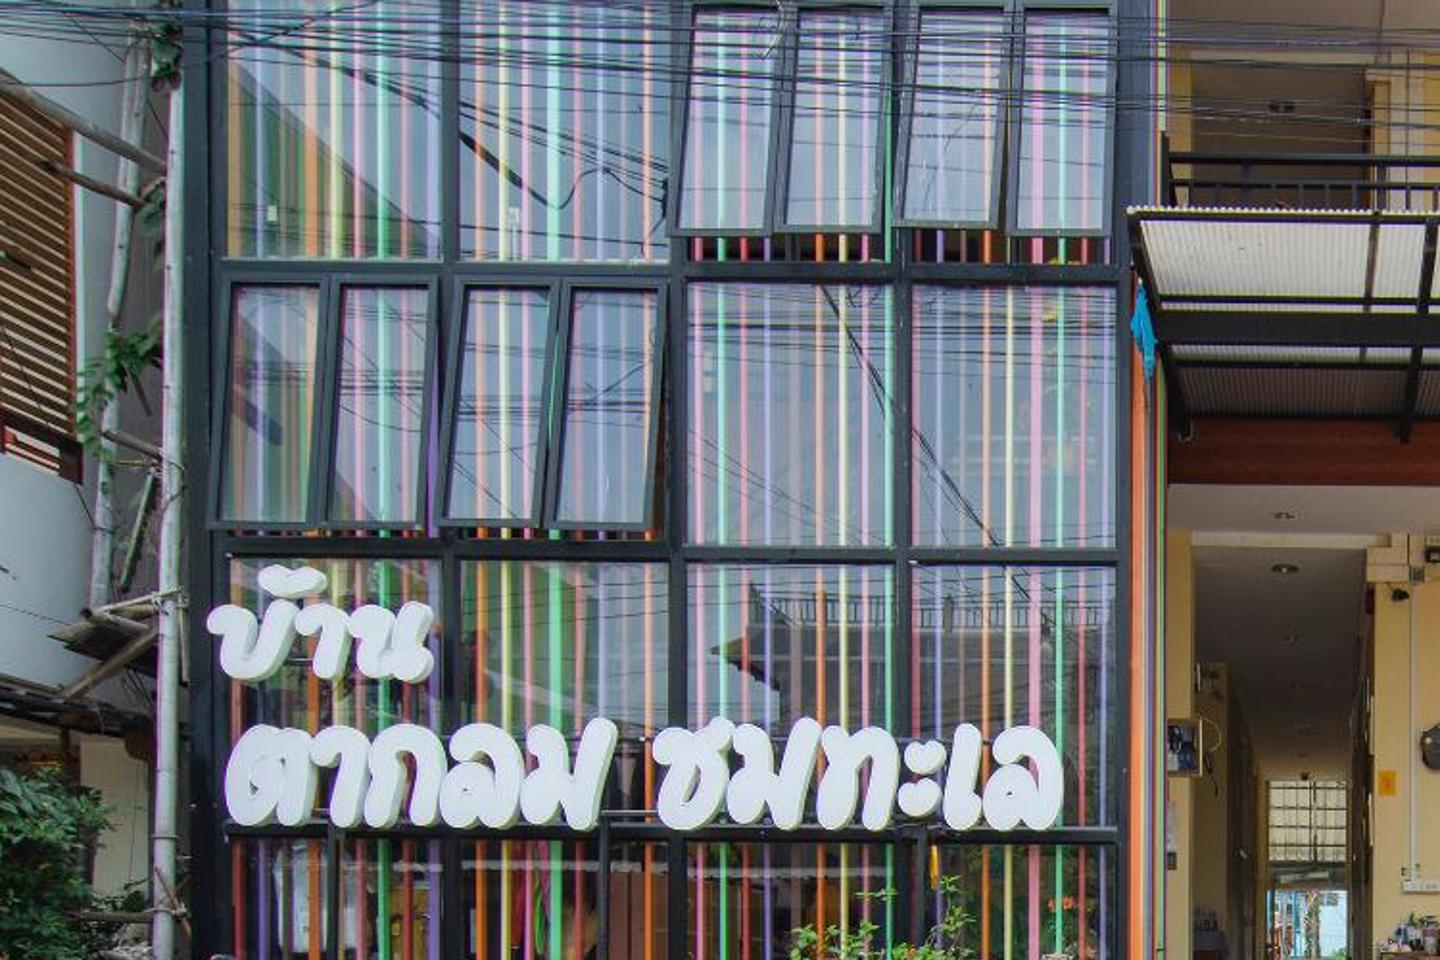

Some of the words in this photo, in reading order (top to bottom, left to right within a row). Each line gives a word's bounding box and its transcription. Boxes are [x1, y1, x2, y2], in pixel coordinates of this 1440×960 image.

[207, 564, 434, 683] บ้าน
[224, 717, 619, 831] ตากลม
[652, 716, 1064, 831] ชมทะเล
